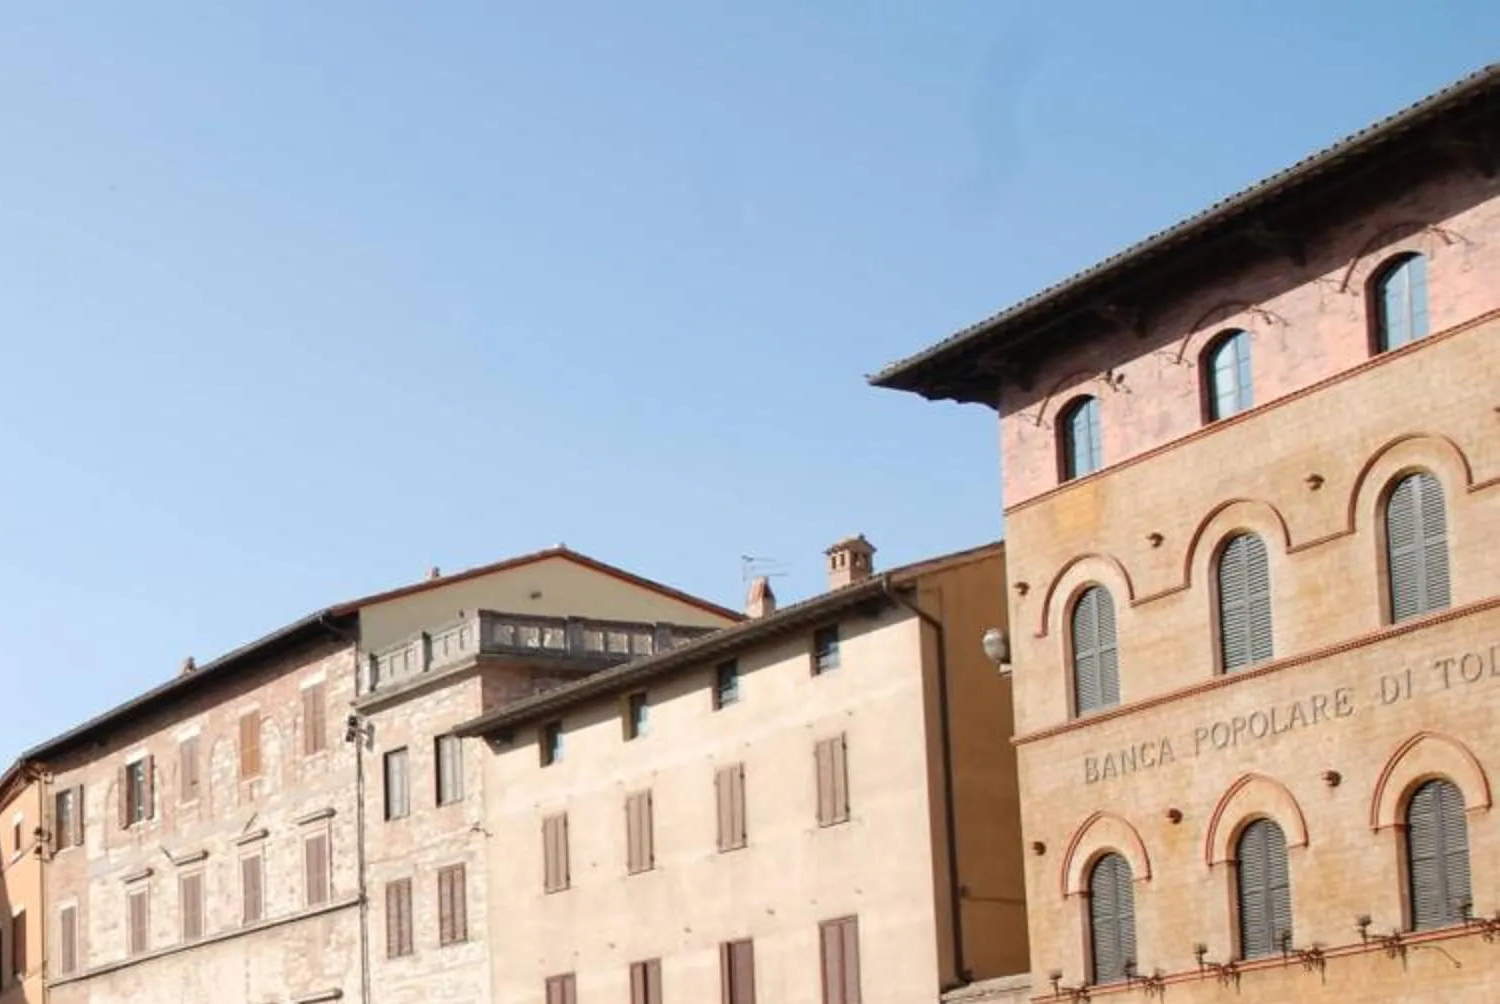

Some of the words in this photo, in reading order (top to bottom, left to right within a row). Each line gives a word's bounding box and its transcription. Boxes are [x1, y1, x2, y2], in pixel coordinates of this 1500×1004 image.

[1084, 741, 1175, 785] BANCA
[1194, 687, 1354, 757] POPOLARE
[1378, 669, 1413, 706] DI
